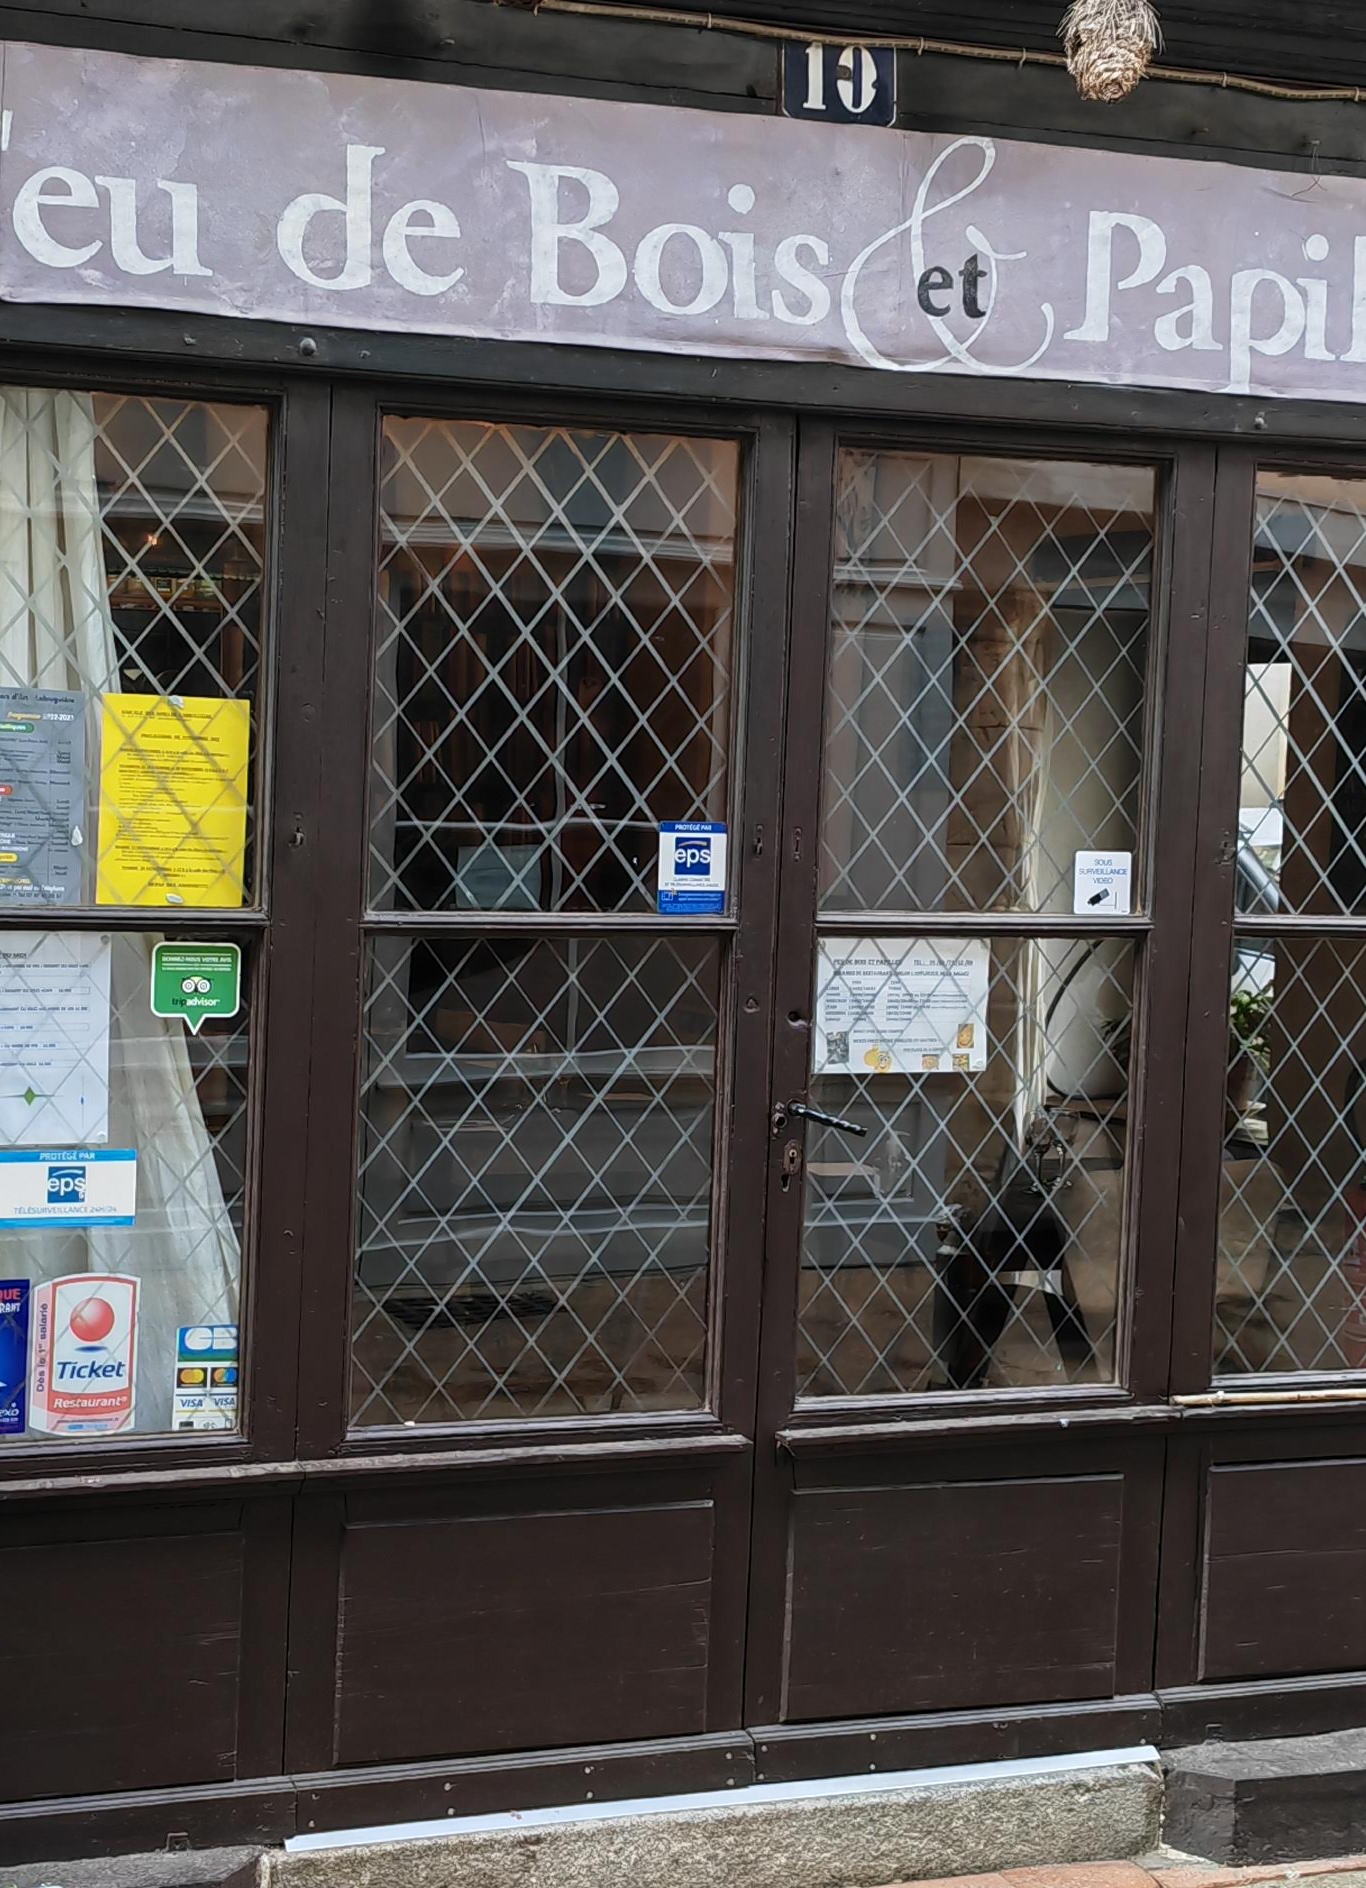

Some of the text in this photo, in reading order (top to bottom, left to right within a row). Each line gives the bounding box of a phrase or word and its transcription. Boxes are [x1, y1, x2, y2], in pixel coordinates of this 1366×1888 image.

[803, 41, 878, 113] 10
[276, 144, 465, 295] de
[506, 159, 833, 326] Bois
[914, 253, 989, 320] et
[675, 848, 711, 867] eps
[171, 996, 220, 1008] tripadvisor
[40, 1150, 95, 1160] PROTÉGÉ PAR
[47, 1177, 85, 1196] eps
[57, 1360, 126, 1379] Ticket
[214, 1398, 235, 1406] VISA
